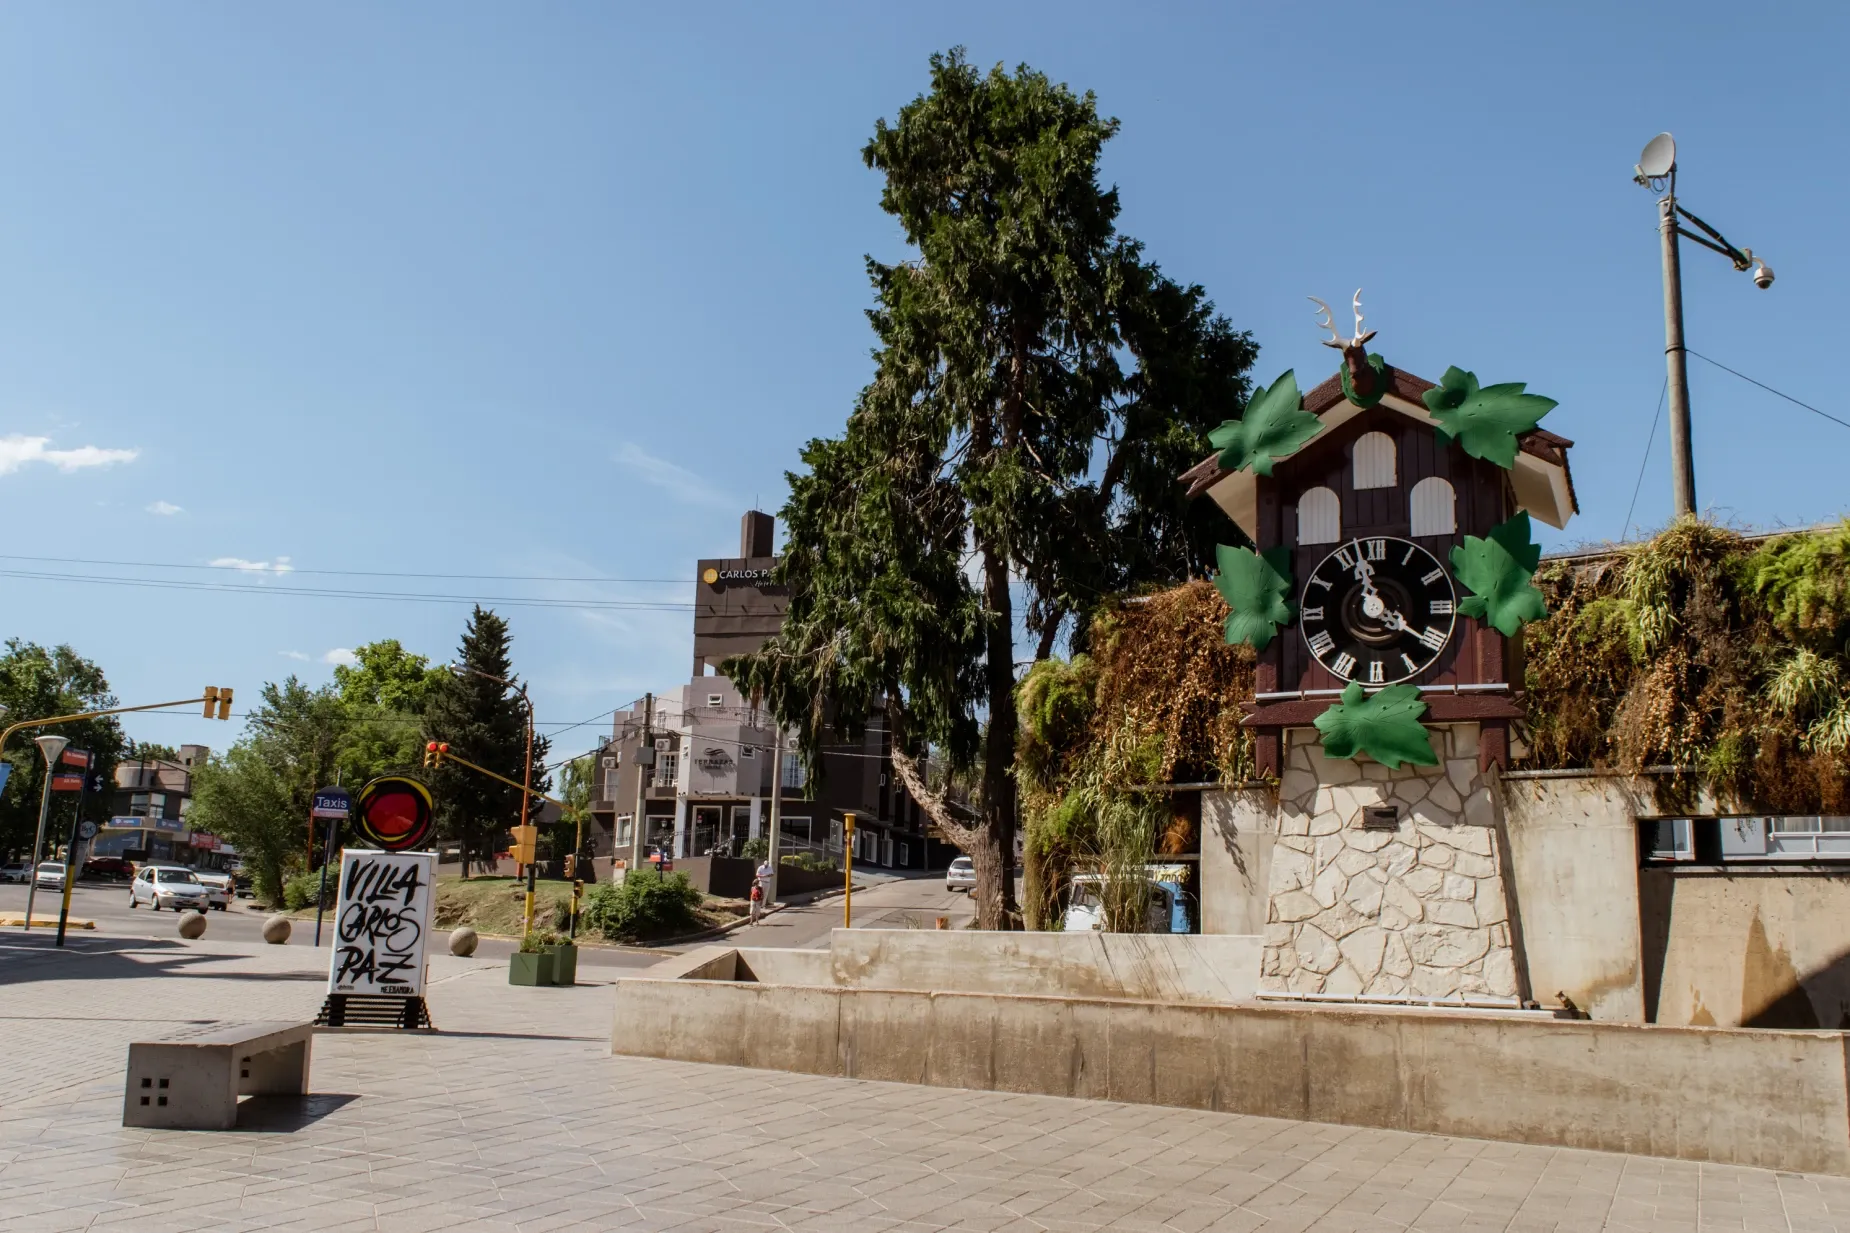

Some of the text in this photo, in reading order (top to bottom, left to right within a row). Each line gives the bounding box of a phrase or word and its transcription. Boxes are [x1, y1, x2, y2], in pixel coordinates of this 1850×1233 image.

[1333, 548, 1356, 571] XI
[1366, 539, 1386, 561] XII
[1401, 546, 1415, 566] I
[719, 569, 758, 579] CARLOS
[1311, 575, 1334, 591] X
[1420, 568, 1444, 586] II
[1302, 606, 1325, 621] IX
[1429, 600, 1453, 615] III
[1308, 629, 1336, 658] VIII
[1331, 651, 1357, 677] VII
[1369, 660, 1385, 683] VI
[1400, 652, 1419, 674] V
[316, 796, 348, 809] Taxis
[345, 858, 427, 906] VILLA
[339, 902, 421, 953] CARLOS
[336, 945, 417, 984] PAZ
